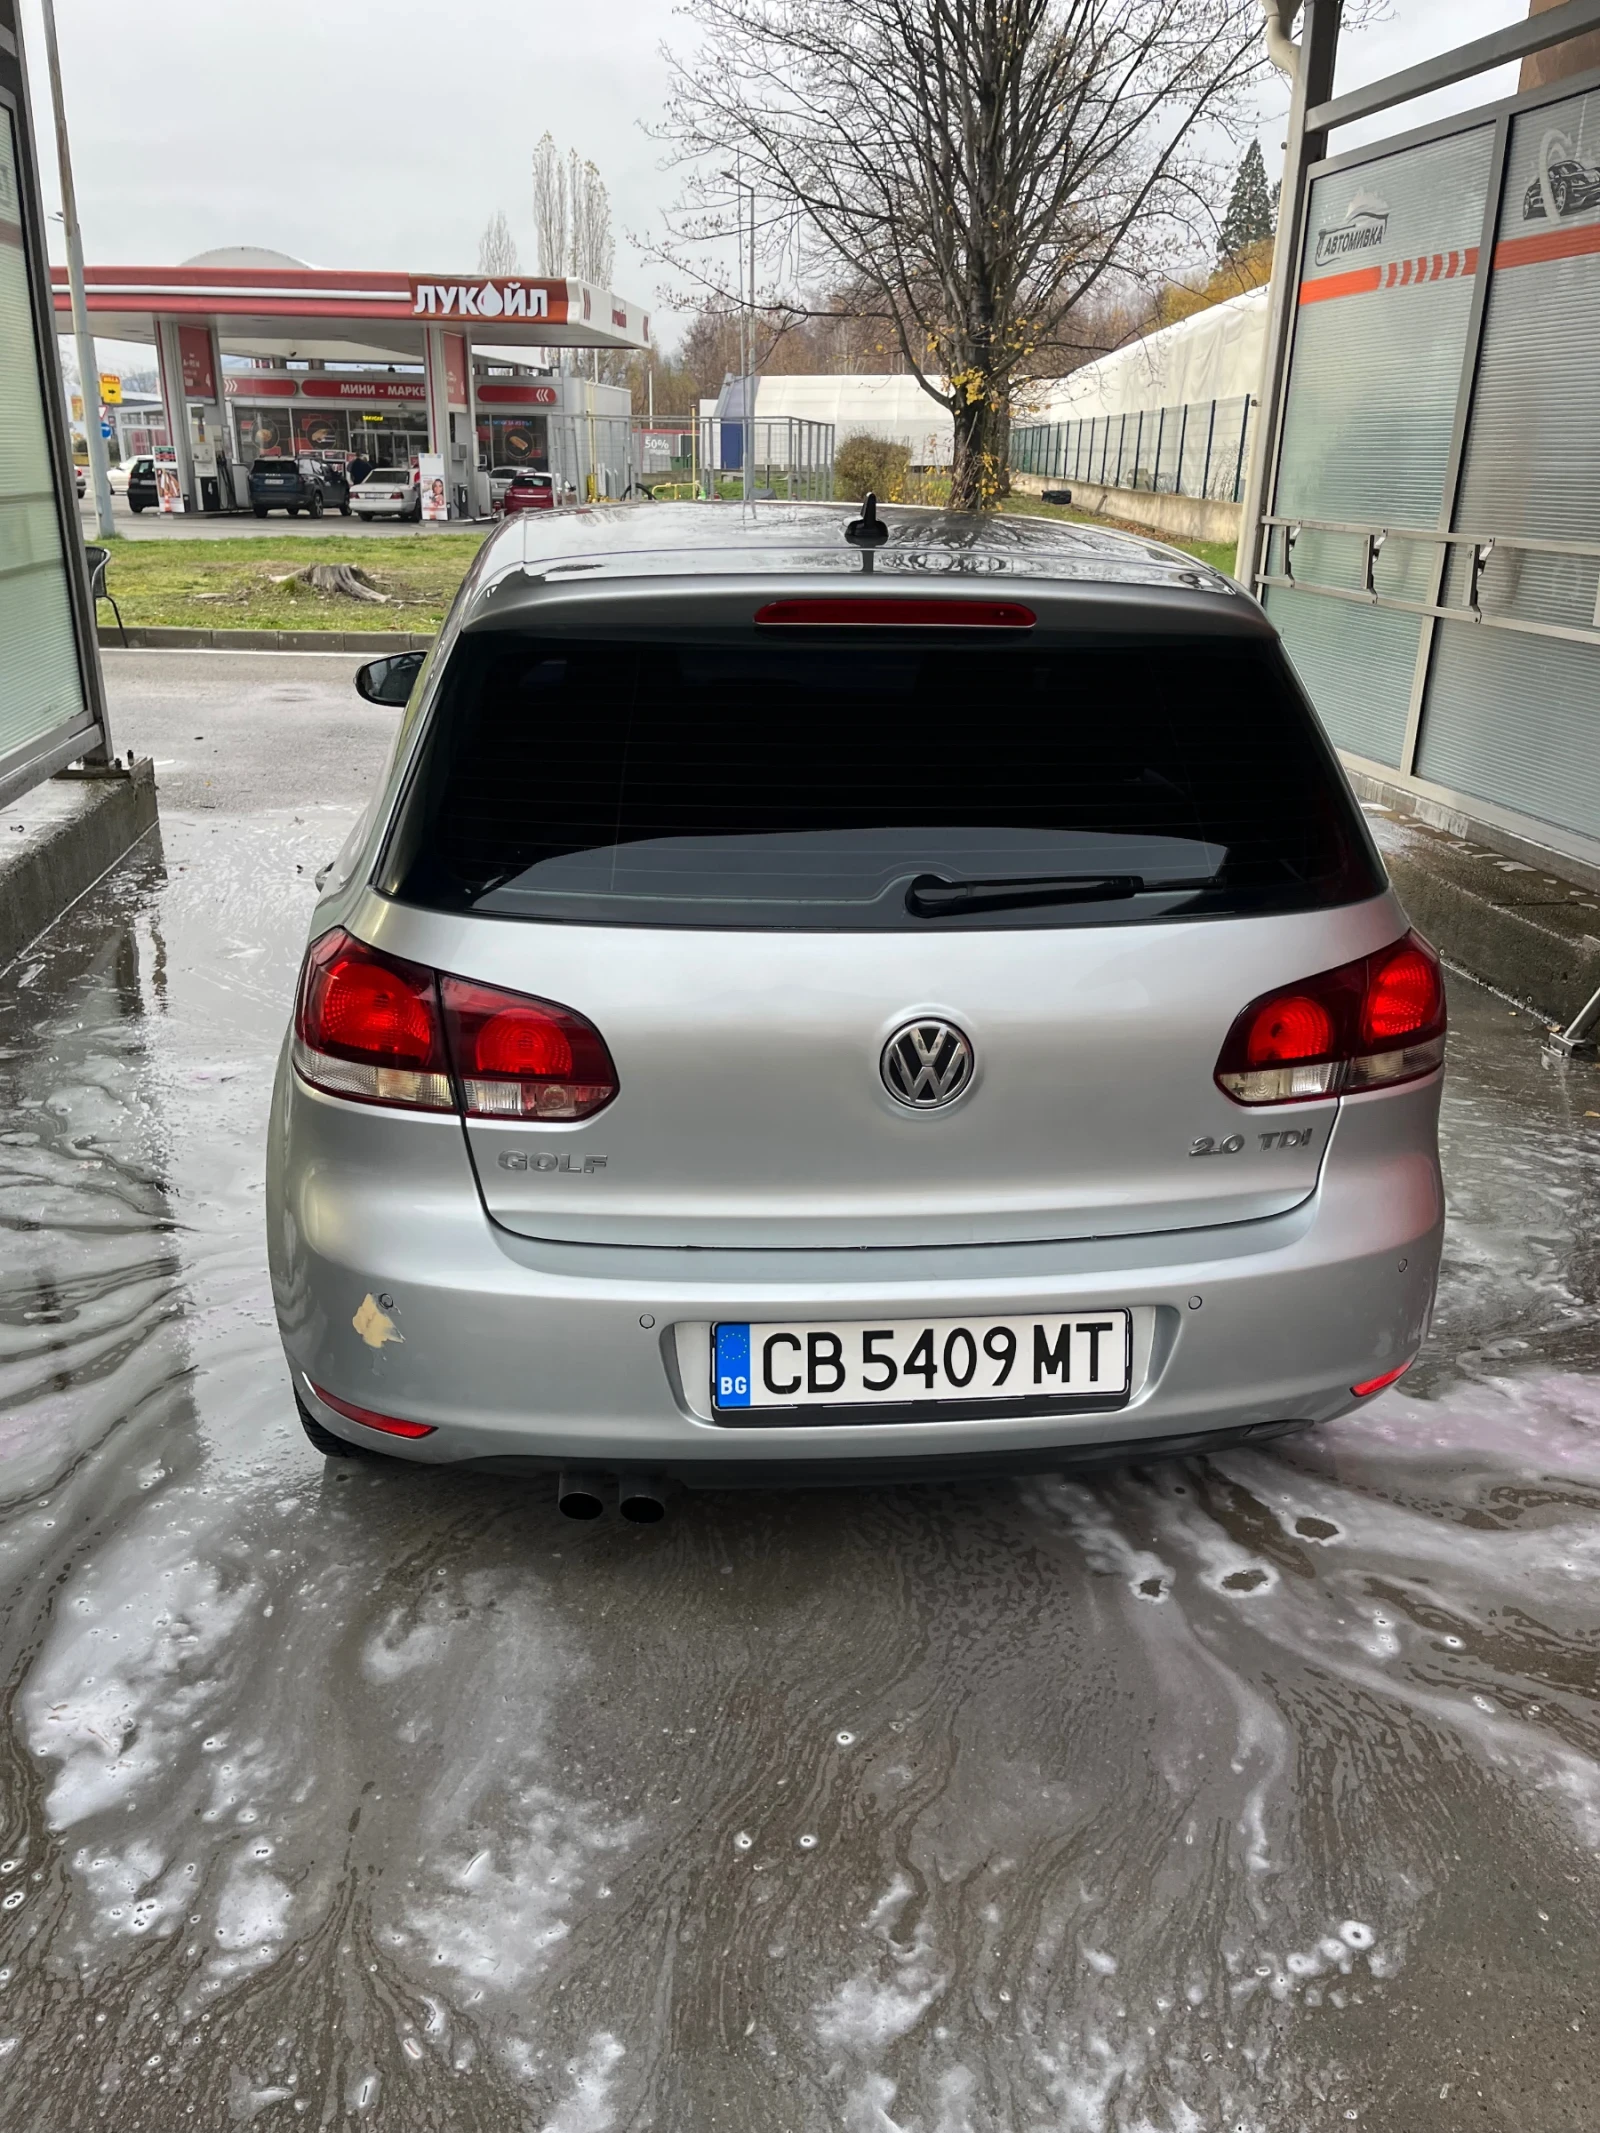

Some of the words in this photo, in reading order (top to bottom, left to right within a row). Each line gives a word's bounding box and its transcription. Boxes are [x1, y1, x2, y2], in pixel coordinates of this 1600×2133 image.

[1324, 226, 1383, 256] АВТОМИВКА
[414, 281, 548, 317] ЛУКОЙЛ
[340, 383, 376, 395] МИНИ
[387, 385, 427, 397] МАРКЕ
[644, 438, 670, 450] 50%
[1189, 1133, 1245, 1156] 2.0
[1258, 1128, 1313, 1151] TDI
[498, 1149, 608, 1173] GOLF
[763, 1331, 845, 1394] CB
[862, 1326, 1017, 1391] 5409
[1033, 1322, 1113, 1384] MT
[720, 1377, 747, 1395] BG
